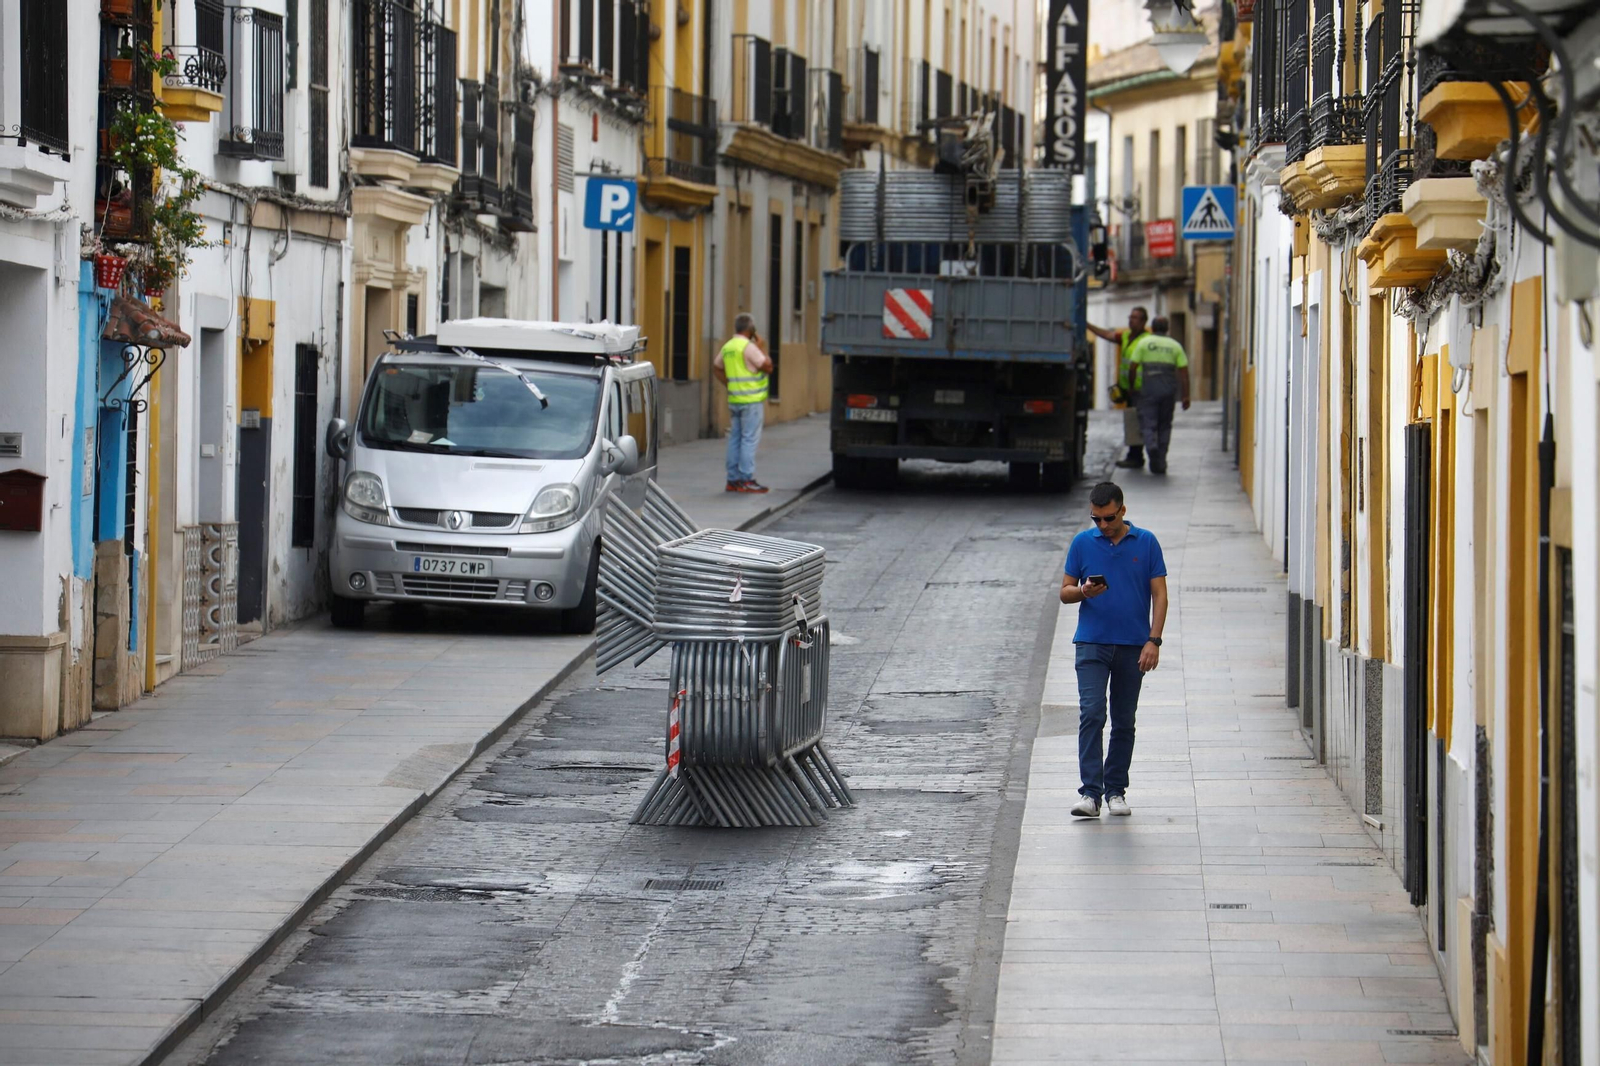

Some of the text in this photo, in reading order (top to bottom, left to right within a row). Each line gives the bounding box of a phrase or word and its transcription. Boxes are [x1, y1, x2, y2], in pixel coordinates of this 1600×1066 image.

[1053, 3, 1079, 163] ALFAROS
[599, 183, 630, 223] P
[422, 558, 485, 575] 0737 CWP
